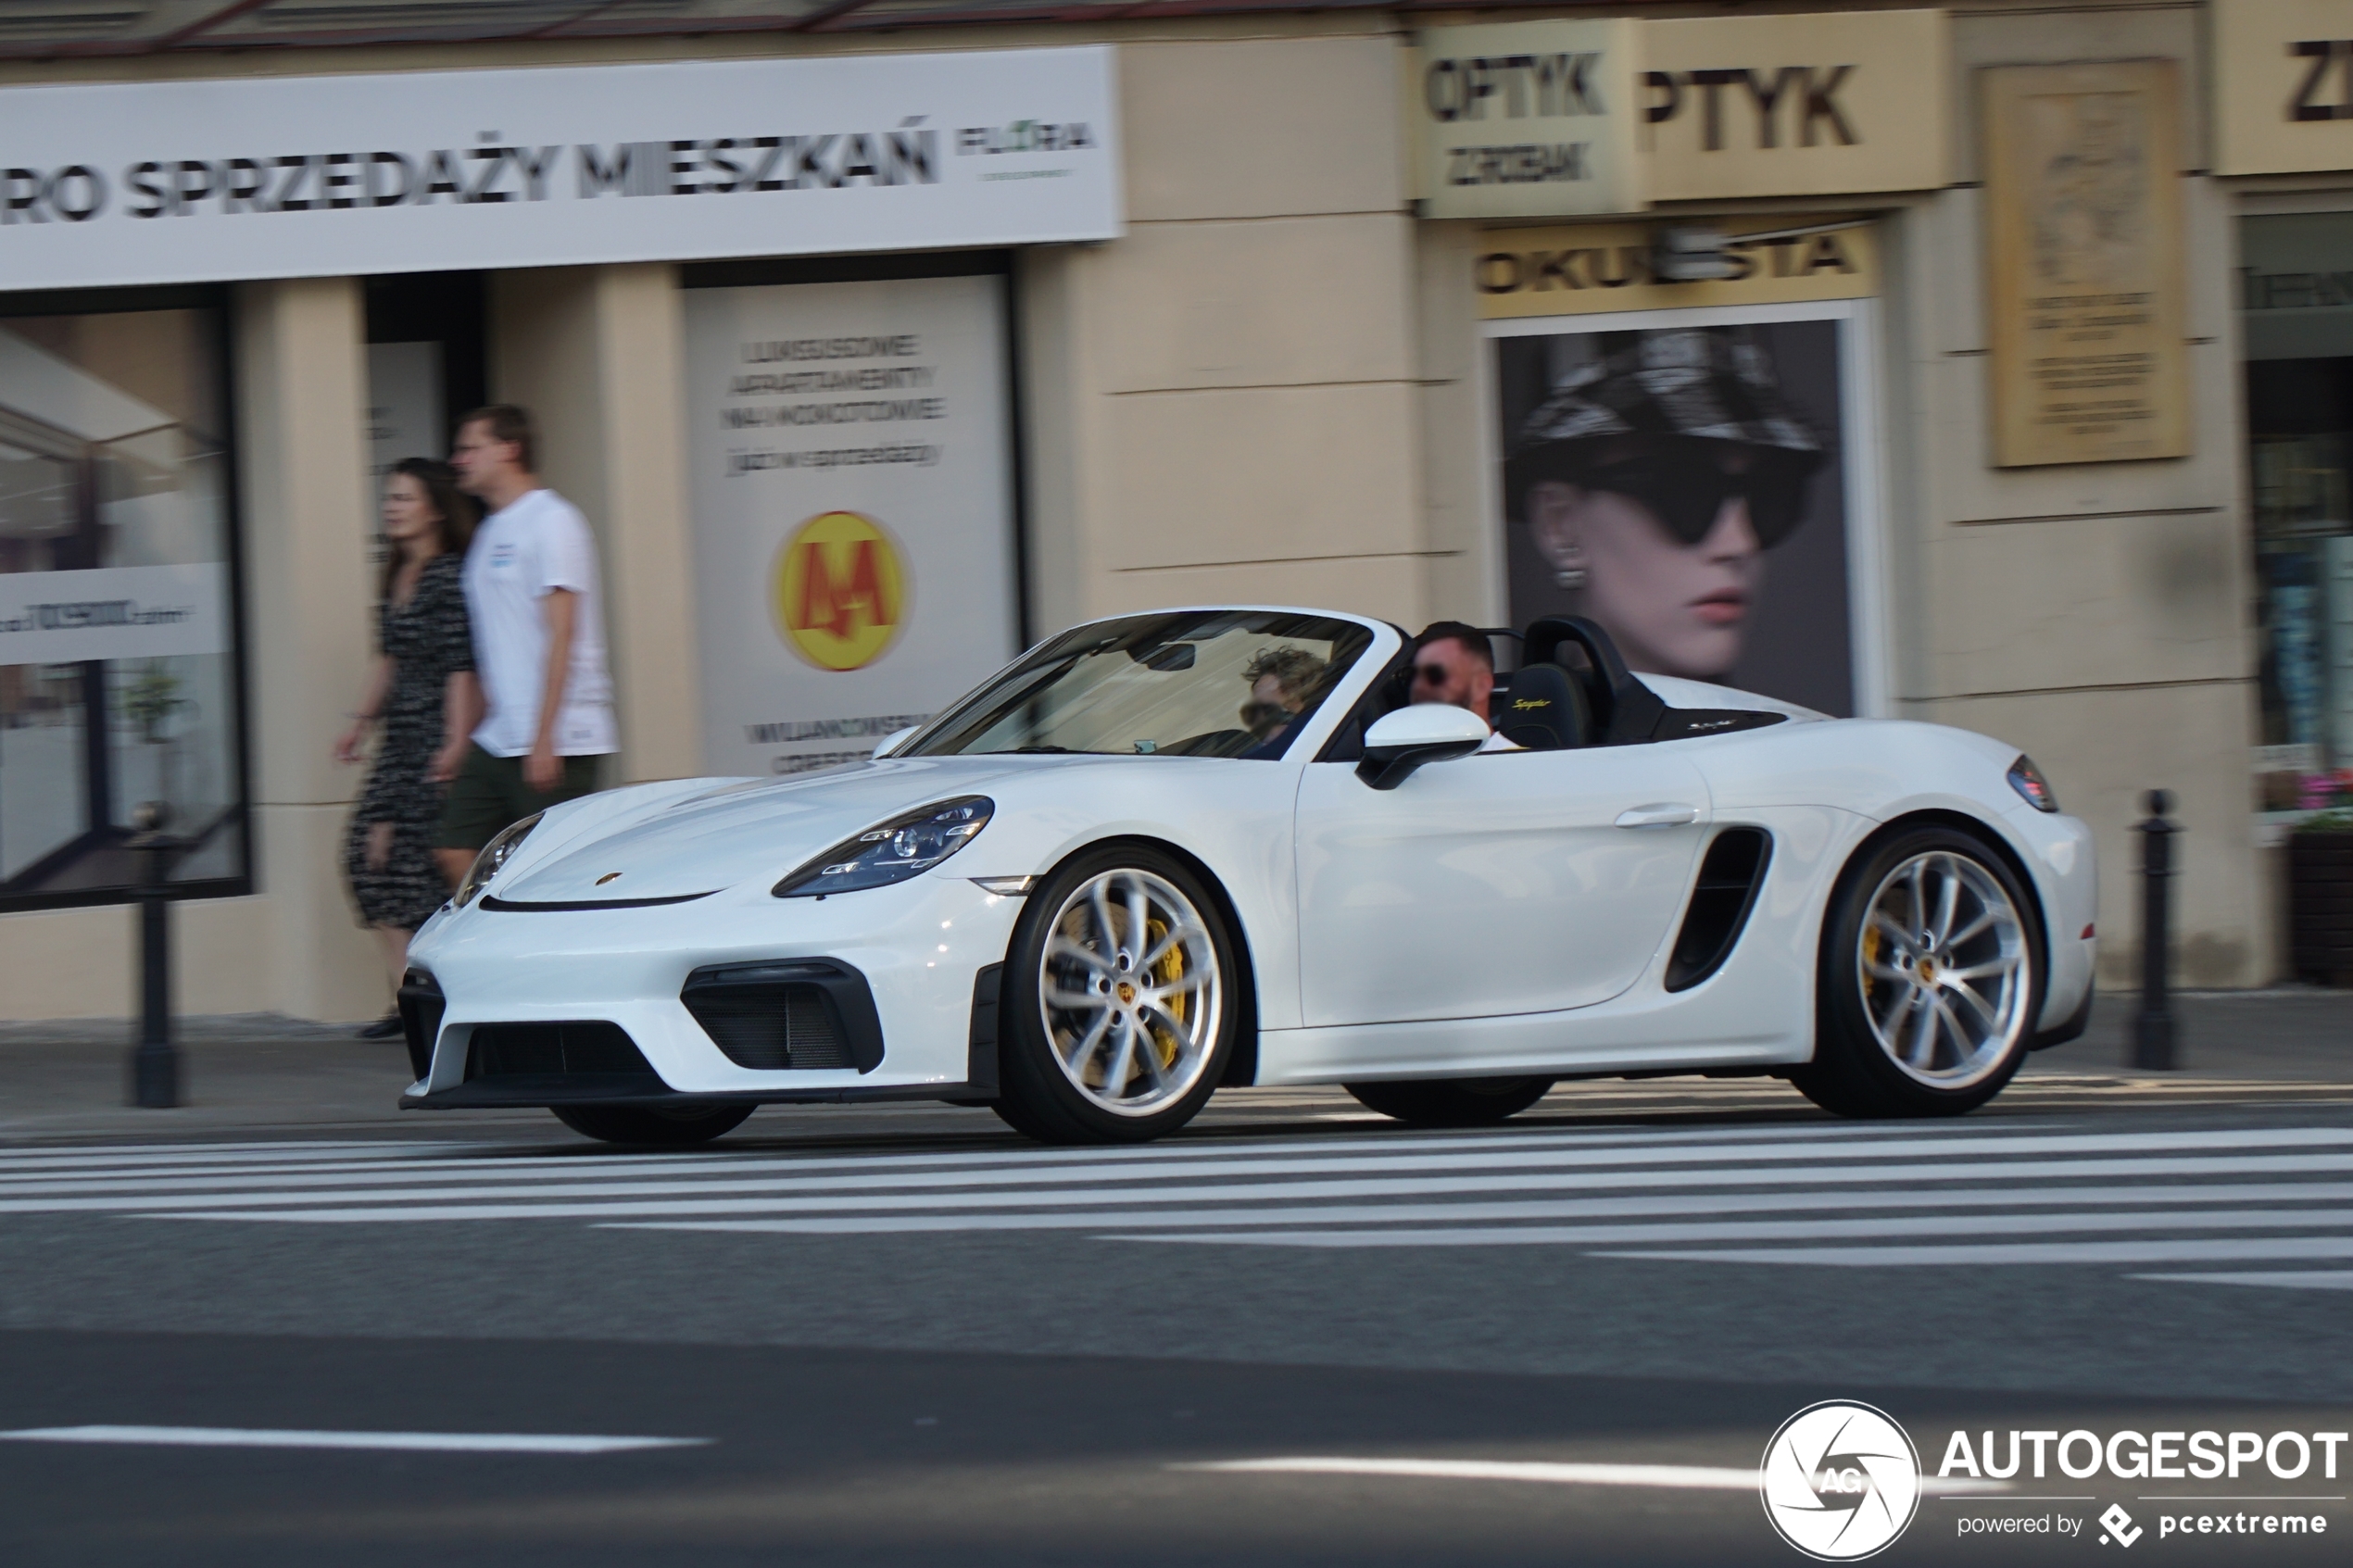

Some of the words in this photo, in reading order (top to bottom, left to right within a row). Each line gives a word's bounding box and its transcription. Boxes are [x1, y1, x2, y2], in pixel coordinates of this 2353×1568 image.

[1425, 50, 1607, 123] OPTYK
[123, 130, 562, 219] SPRZEDAŻY
[574, 114, 940, 199] MIESZKAŃ
